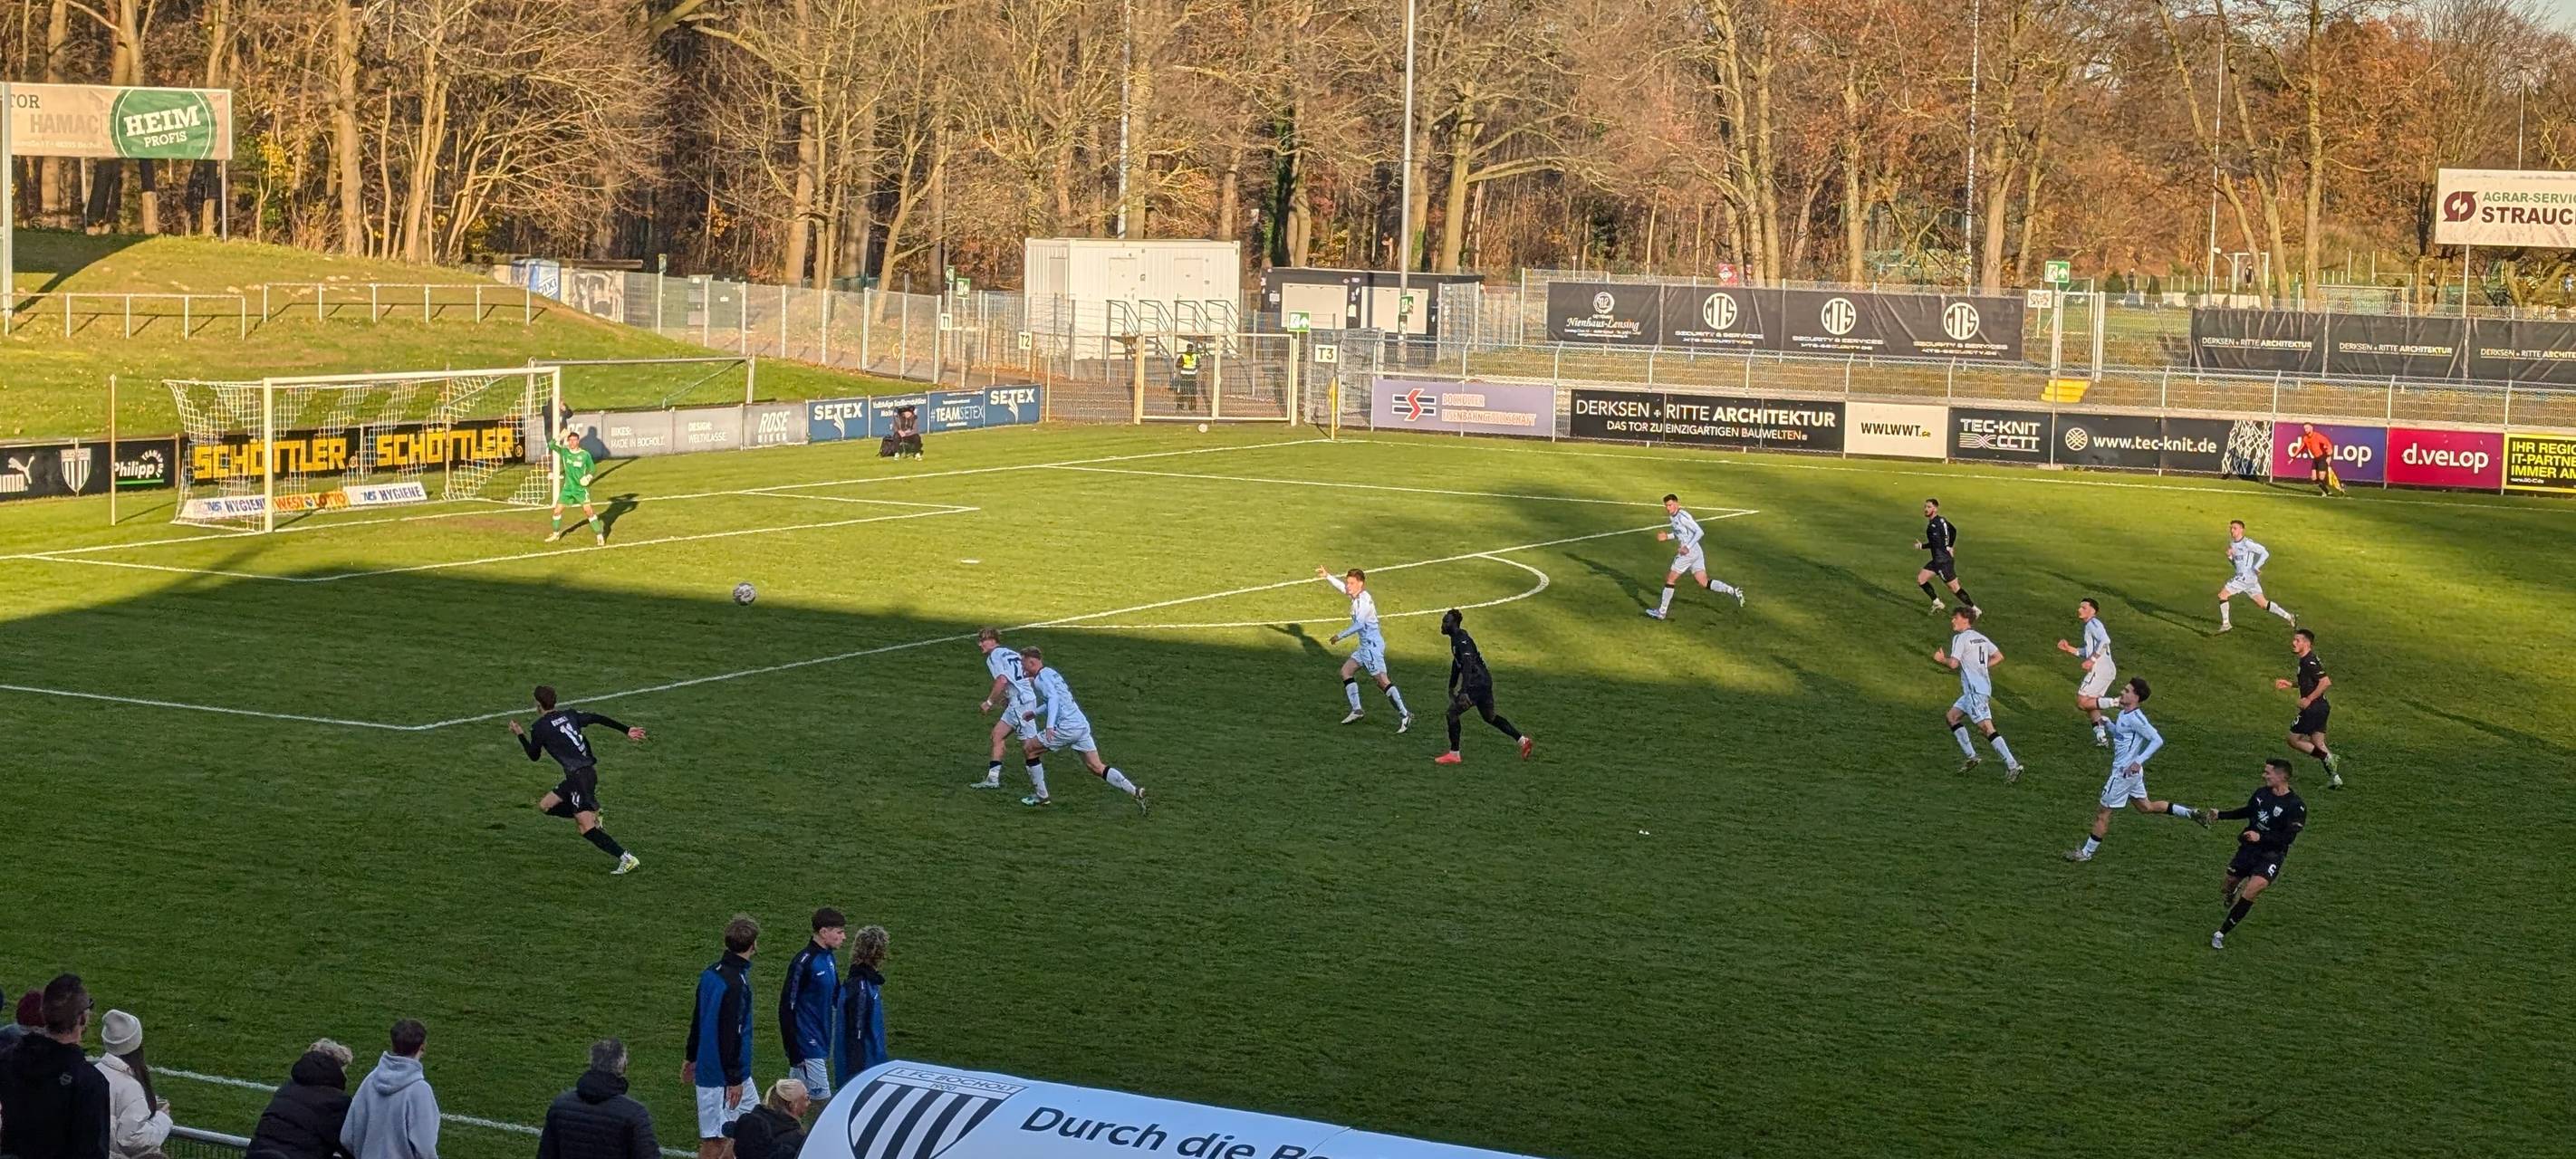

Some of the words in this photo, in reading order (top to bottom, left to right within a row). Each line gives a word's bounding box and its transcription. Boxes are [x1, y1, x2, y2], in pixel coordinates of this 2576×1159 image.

[123, 105, 200, 136] HEIM
[144, 130, 187, 148] PROFIS
[2481, 206, 2576, 225] STRAUC
[1704, 294, 1736, 328] MTS
[1821, 298, 1856, 334] MTS
[1944, 302, 1979, 340] MTS
[1020, 334, 1030, 348] T2
[2201, 336, 2235, 345] DERKSEN
[2260, 340, 2312, 349] ARCHITEKTUR
[2339, 342, 2373, 351] DERKSEN
[2399, 346, 2452, 355] ARCHITEKTUR
[1318, 348, 1334, 360] T3
[2480, 349, 2515, 357] DERKSEN
[989, 388, 1035, 405] SETEX
[813, 401, 863, 421] SETEX
[930, 406, 984, 423] #TEAMSETEX
[1576, 399, 1649, 417] DERKSEN
[1667, 404, 1710, 421] RITTE
[1712, 407, 1836, 427] ARCHITEKTUR
[758, 411, 790, 433] ROSE
[1607, 420, 1627, 431] DAS
[1629, 421, 1648, 432] TOR
[1649, 423, 1663, 433] ZU
[1667, 424, 1739, 437] EINZIGARTIGEN
[1960, 418, 2041, 435] TEC-KNIT
[376, 426, 513, 466] SCHÖTTLER
[610, 438, 629, 450] MADE
[1997, 436, 2041, 449] CCTT
[2093, 436, 2217, 454] www.tec-knit.de
[2512, 441, 2535, 454] IHR
[194, 437, 347, 479] SCHÖTTLER
[113, 461, 155, 479] Philipp
[2511, 465, 2557, 479] IMMER
[379, 485, 423, 501] HYGIENE
[225, 498, 265, 513] HYGIEN
[1978, 646, 1986, 665] 4
[930, 1082, 957, 1091] 1900
[934, 1075, 1017, 1092] BOCHOLT
[1020, 1106, 1168, 1152] Durch
[1177, 1133, 1256, 1159] die
